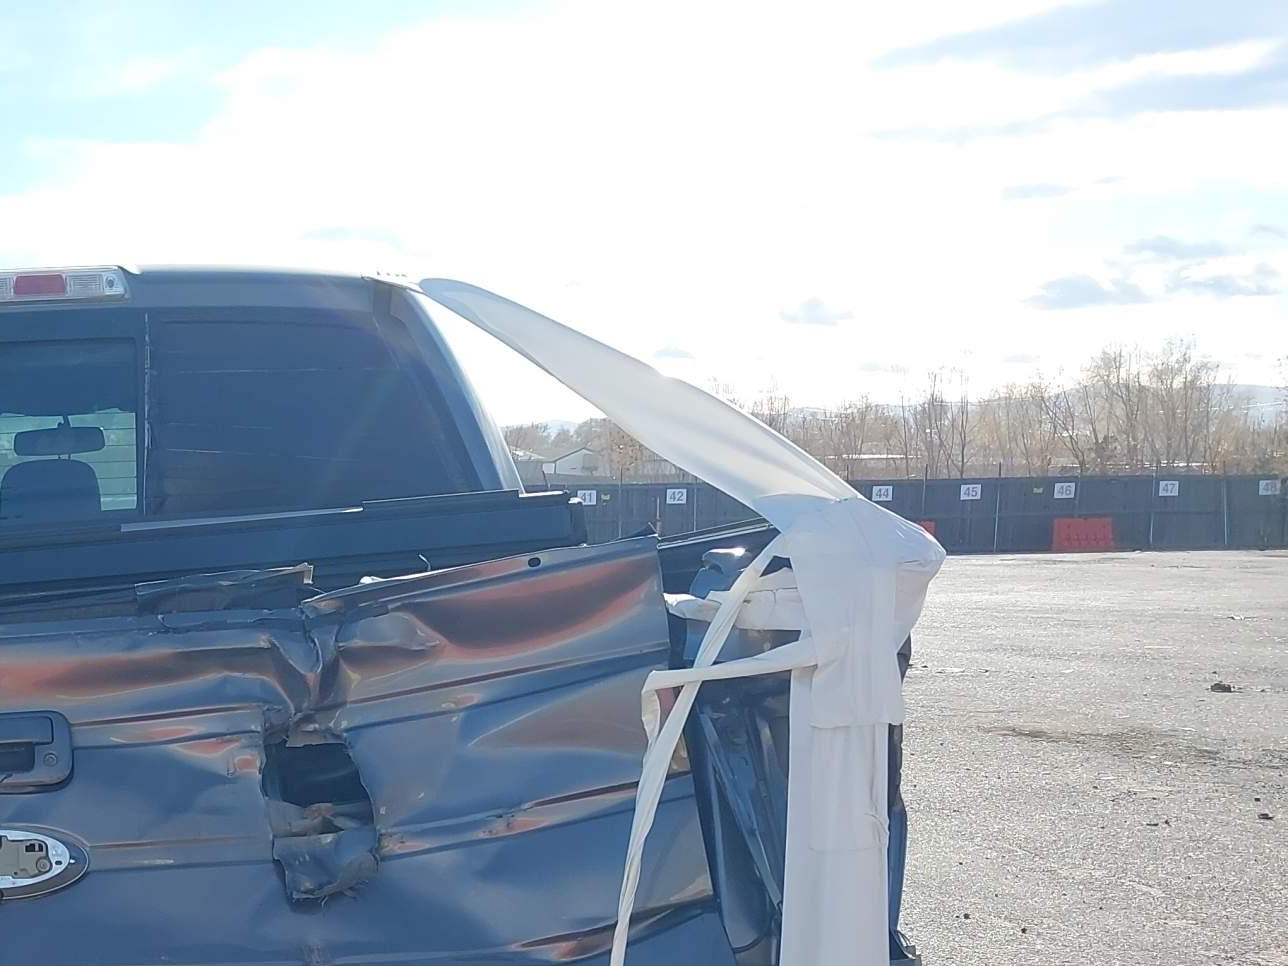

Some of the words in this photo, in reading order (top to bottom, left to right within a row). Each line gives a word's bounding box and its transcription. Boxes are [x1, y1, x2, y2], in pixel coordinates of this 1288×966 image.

[875, 487, 889, 499] 44
[963, 486, 978, 497] 45
[1058, 485, 1072, 497] 46
[1162, 483, 1176, 494] 47
[669, 491, 684, 502] 42
